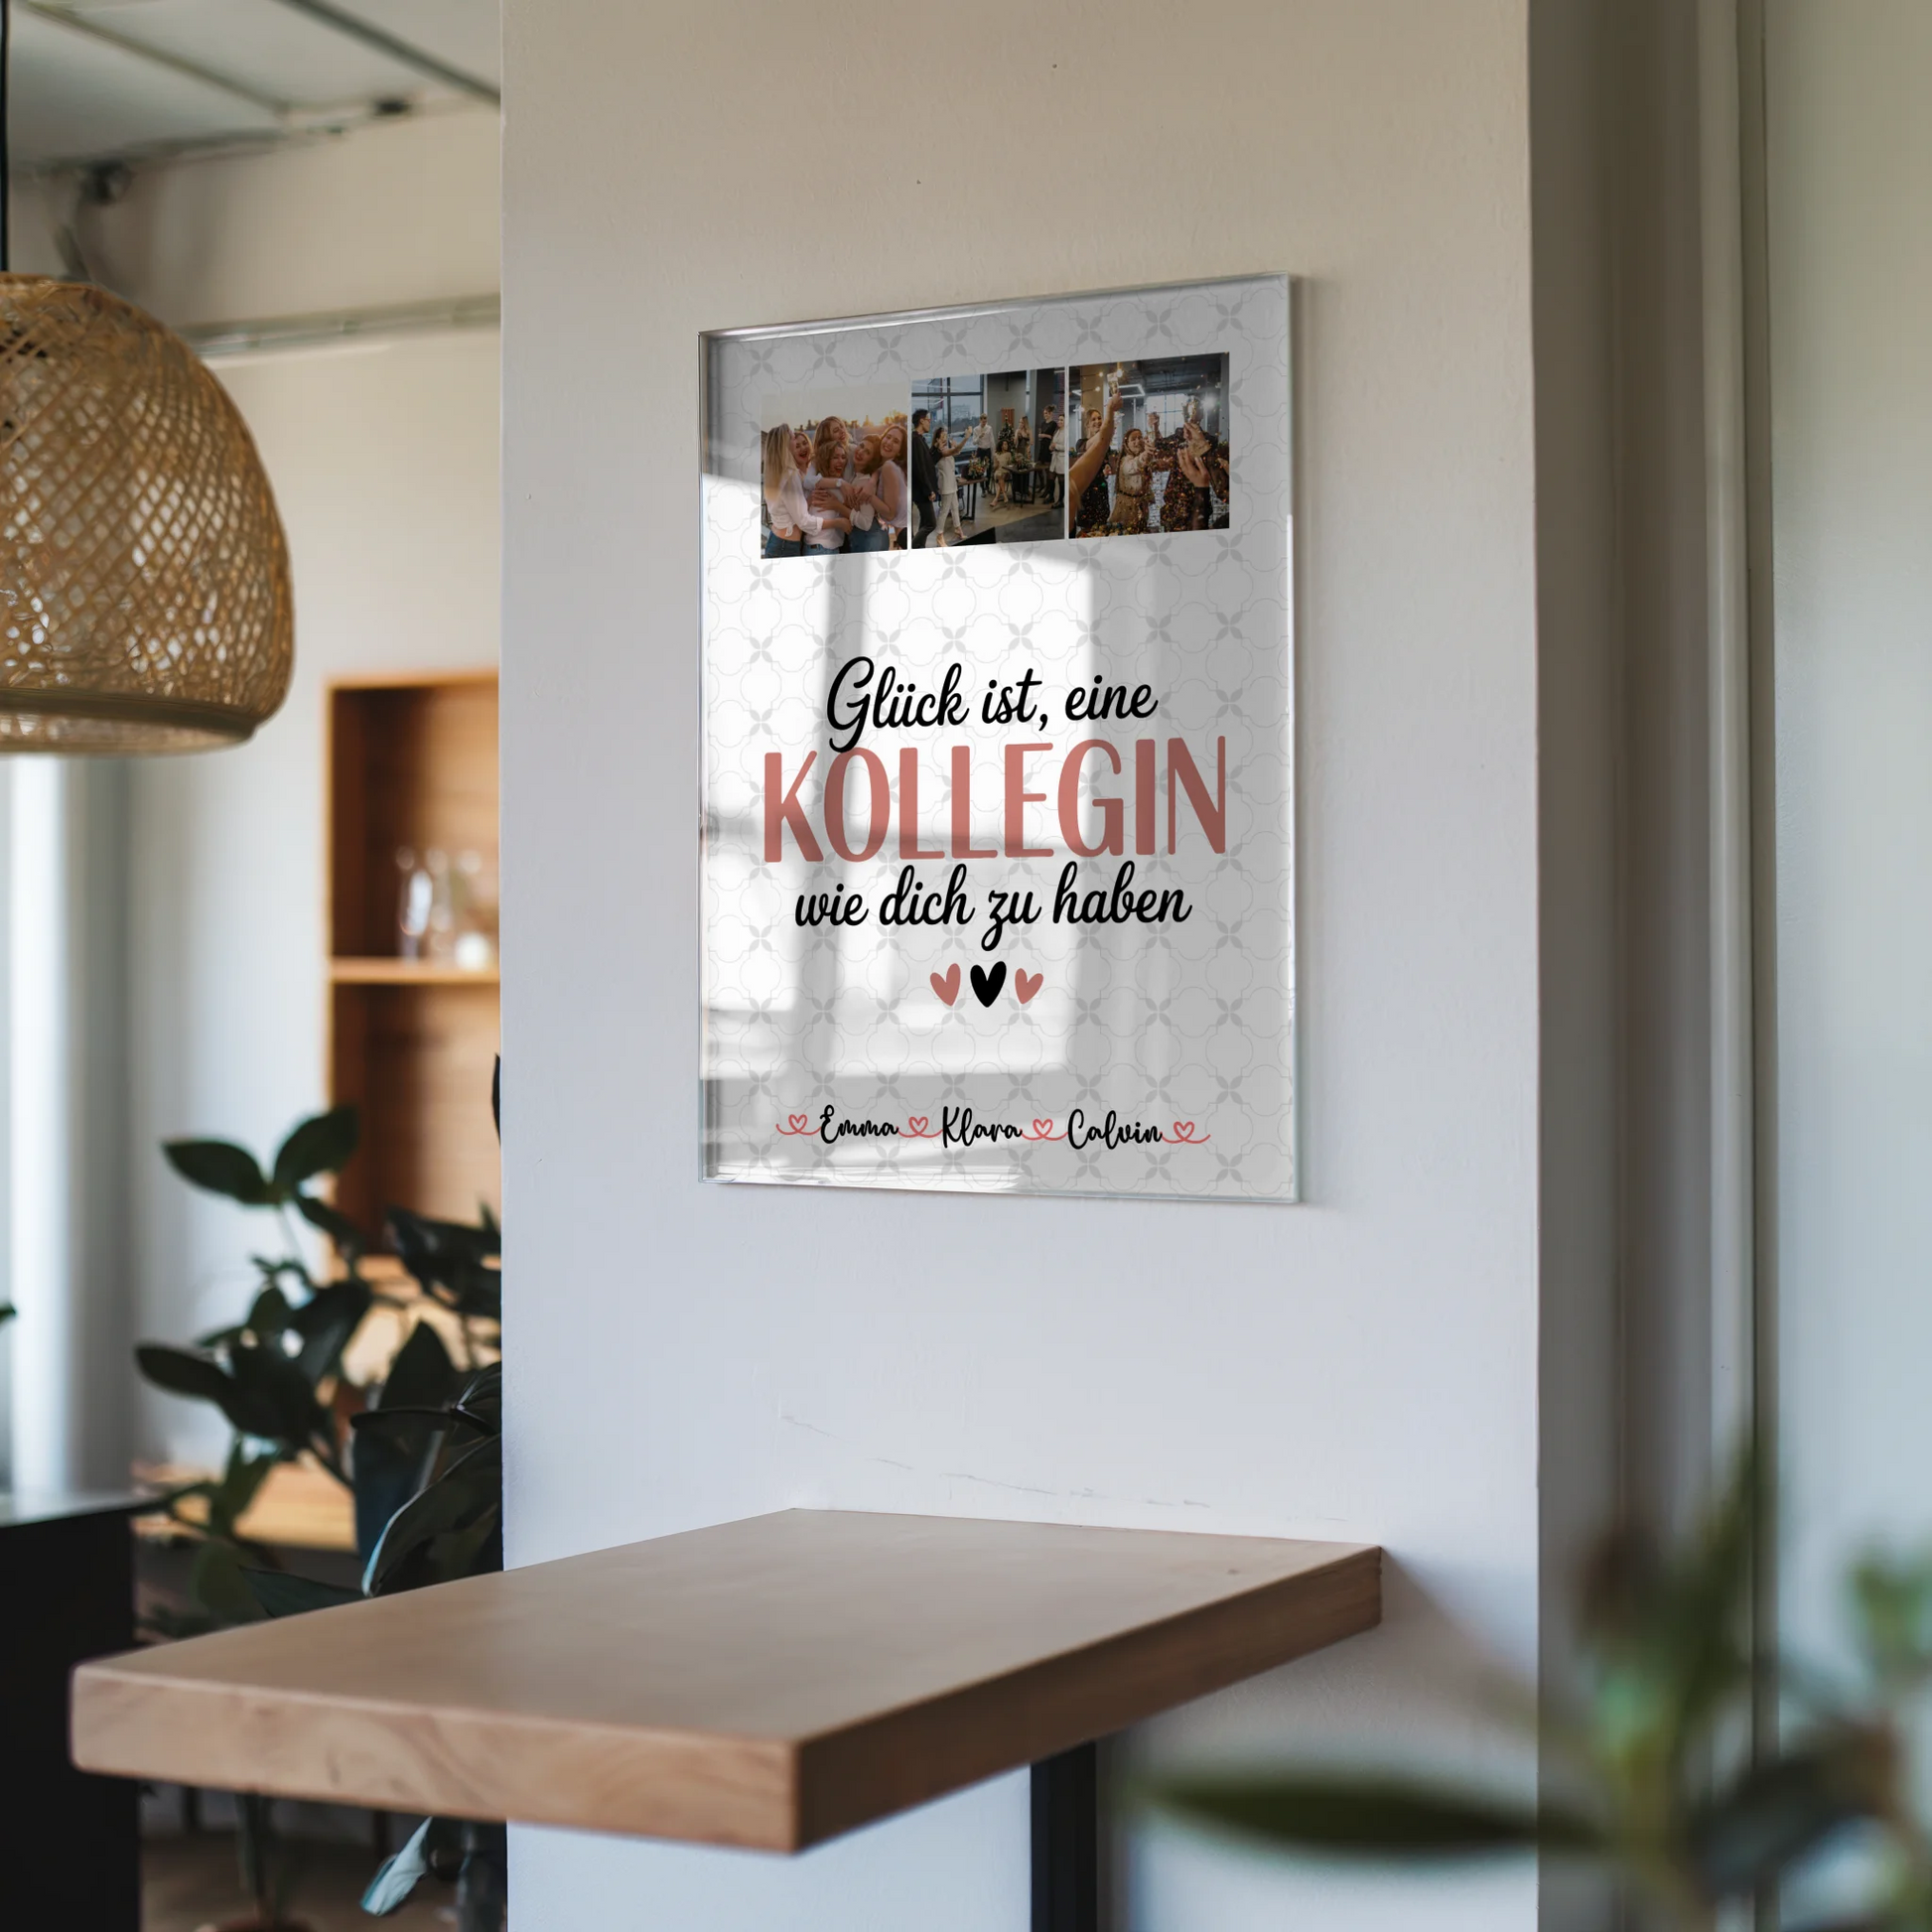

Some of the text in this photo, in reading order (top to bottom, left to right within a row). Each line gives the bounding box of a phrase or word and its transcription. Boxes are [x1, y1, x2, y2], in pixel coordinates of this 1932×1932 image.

[826, 656, 1159, 755] Glück ist, eine
[763, 736, 1225, 863] KOLLEGIN
[794, 860, 1193, 952] wie dich zu haben
[819, 1104, 1164, 1151] Emma Klara Calvin
